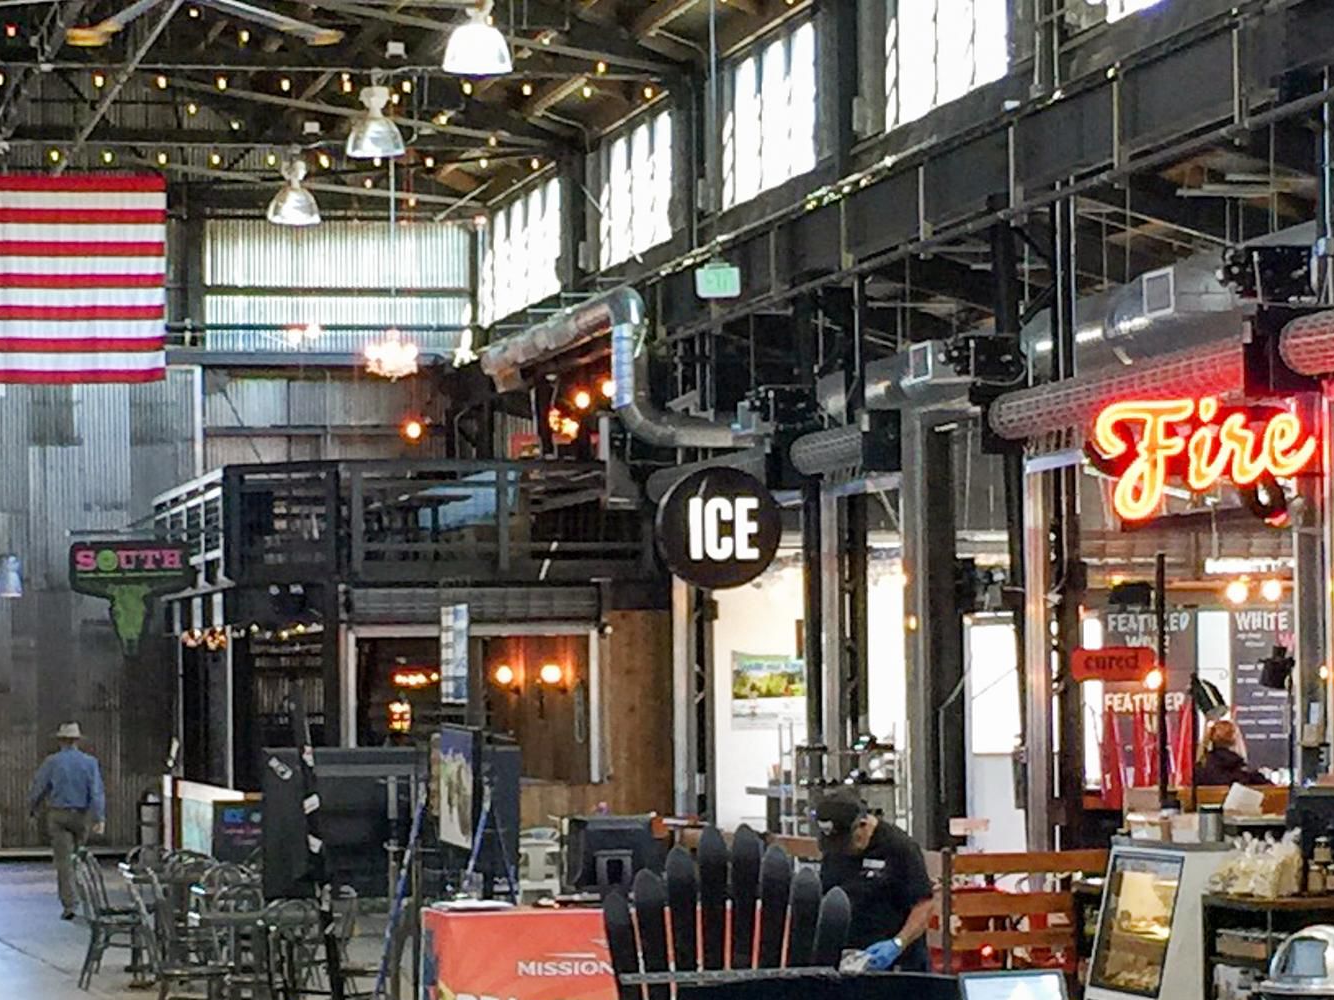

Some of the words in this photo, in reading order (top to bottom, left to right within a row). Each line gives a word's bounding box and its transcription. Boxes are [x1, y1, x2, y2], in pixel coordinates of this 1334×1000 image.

[1095, 396, 1316, 520] Fire
[689, 497, 760, 560] ICE
[74, 548, 182, 571] SOUTH
[1107, 612, 1191, 632] FEATUED
[1236, 612, 1289, 632] WHITE
[1084, 652, 1139, 670] cured
[518, 960, 615, 977] MISSION
